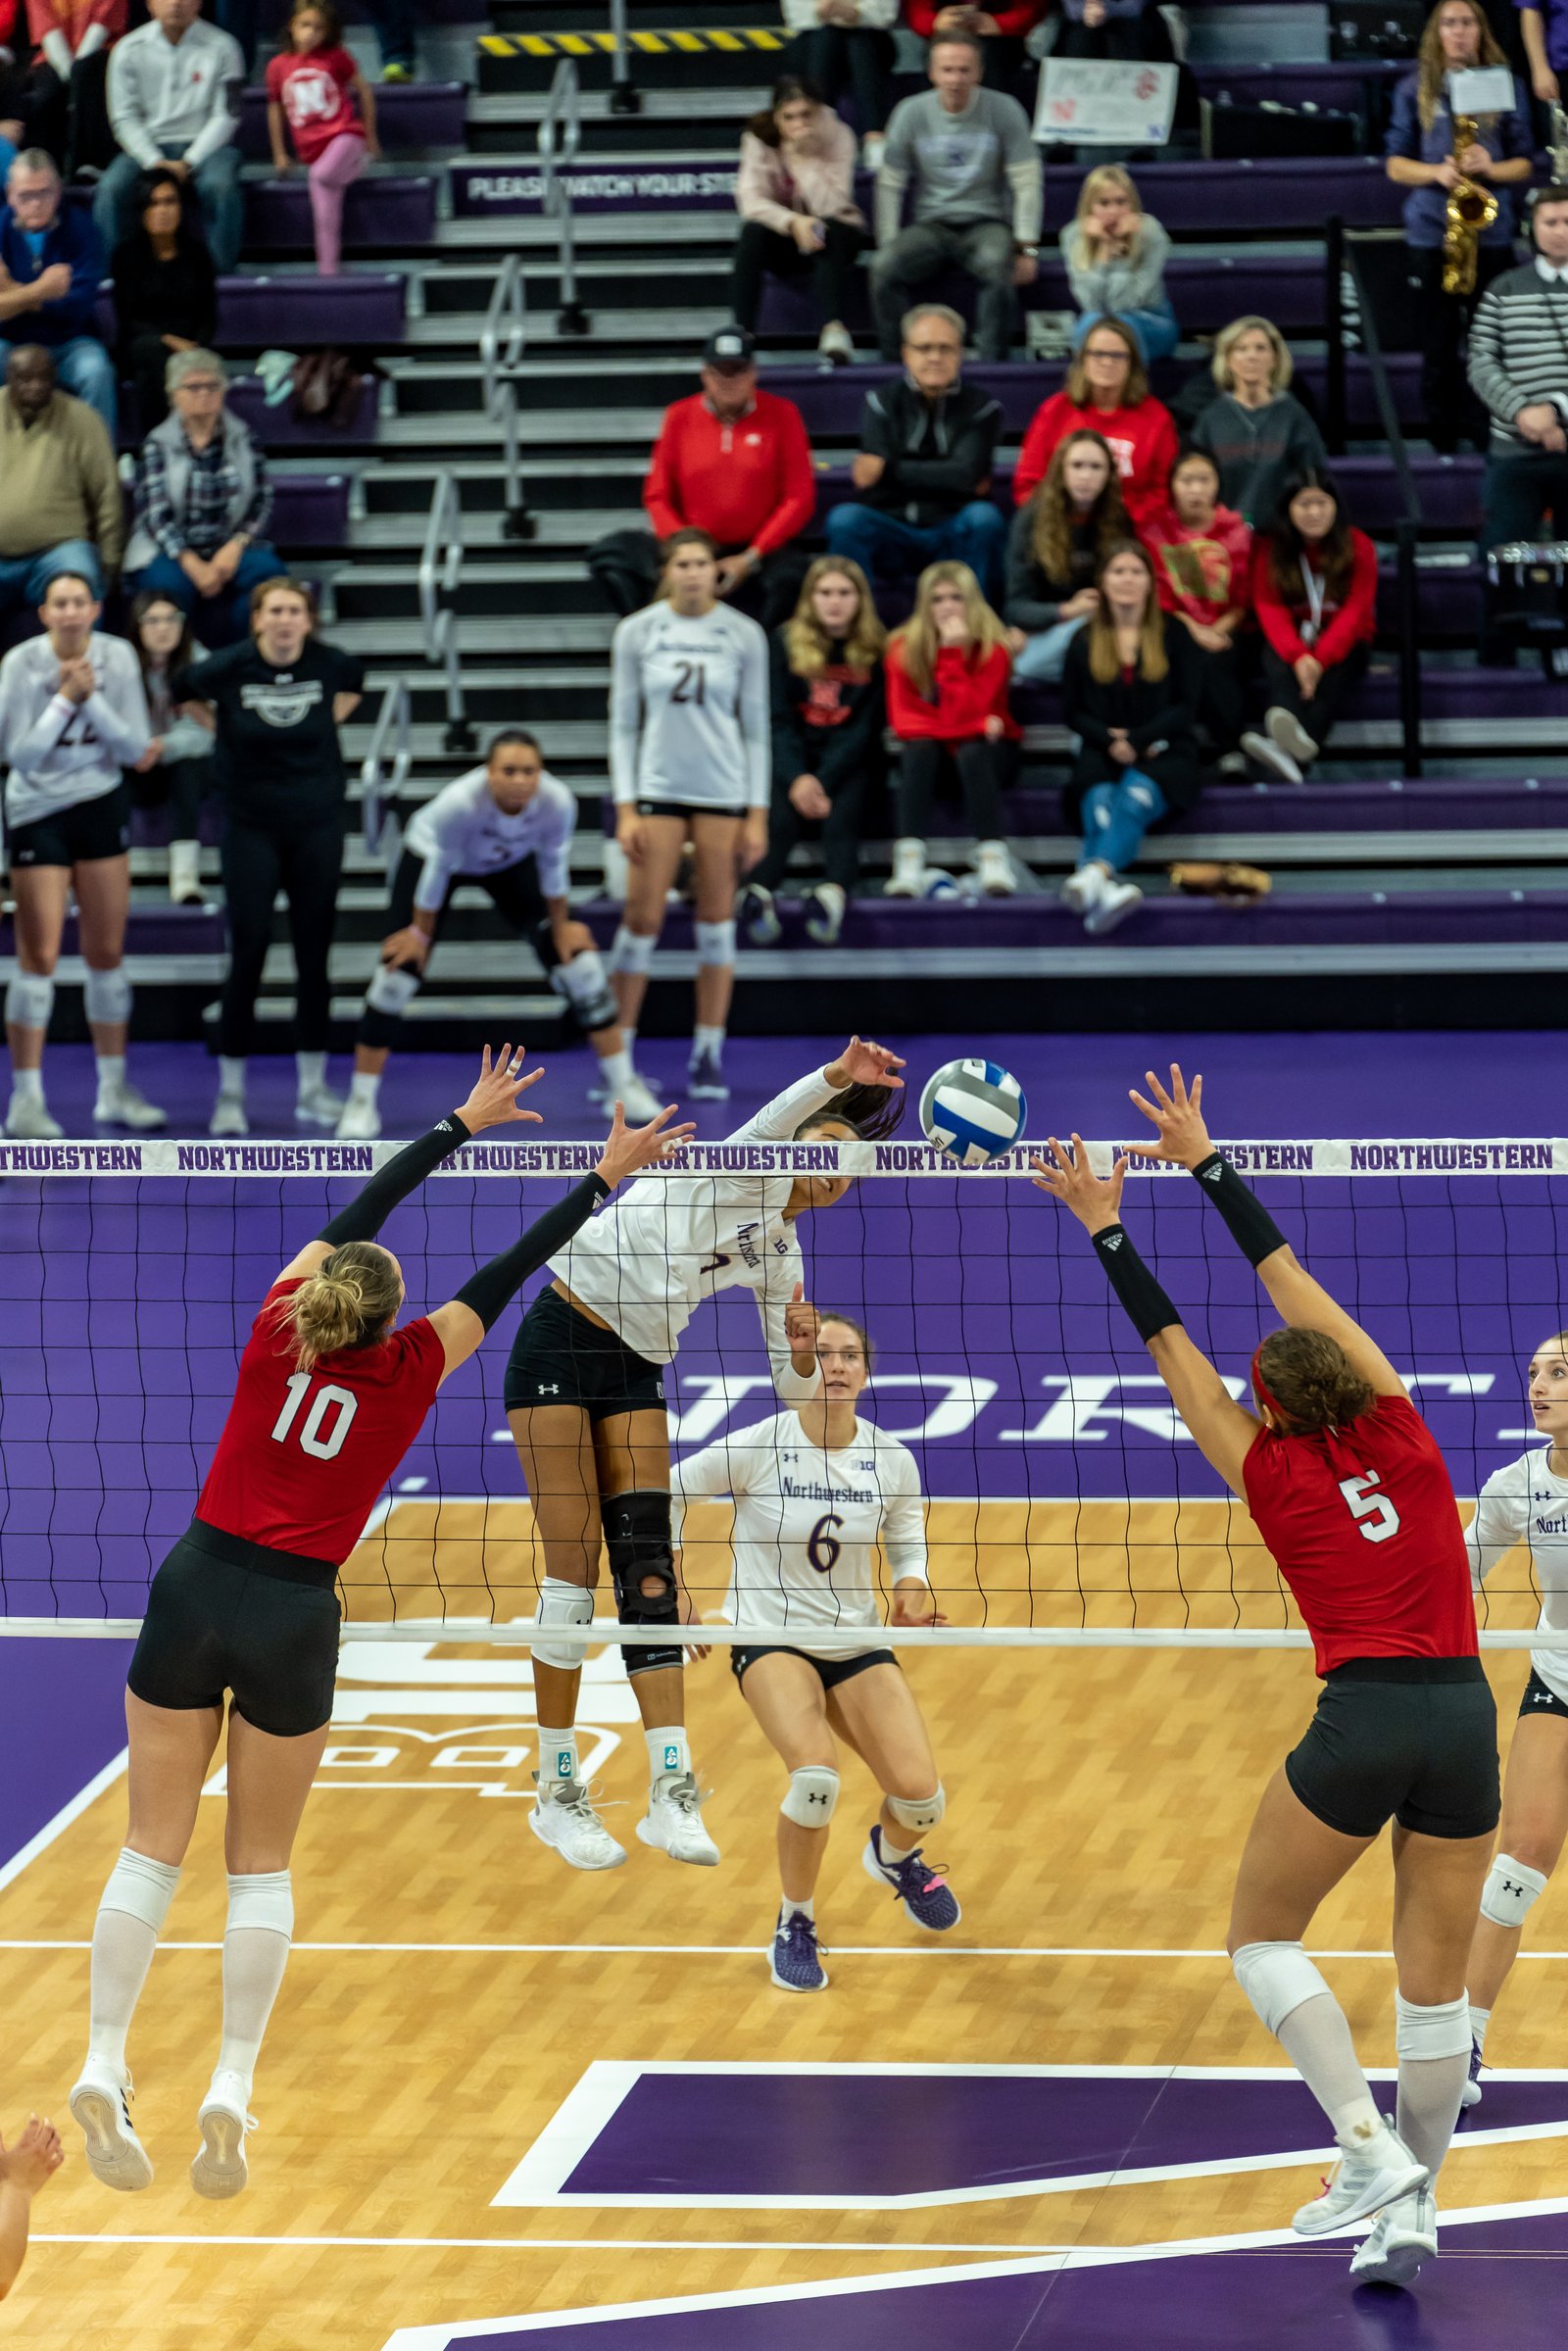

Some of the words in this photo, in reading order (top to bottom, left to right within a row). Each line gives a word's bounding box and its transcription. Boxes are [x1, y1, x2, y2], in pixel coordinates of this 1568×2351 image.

[468, 176, 549, 200] PLEAS
[697, 171, 739, 196] STE
[671, 661, 705, 706] 21
[177, 1146, 373, 1171] NORTHWESTERN
[432, 1146, 602, 1171] RTHWESTERN
[1349, 1144, 1553, 1170] NORTHWESTERN
[270, 1371, 360, 1461] 10
[783, 1476, 873, 1503] Northwestern
[1338, 1469, 1401, 1543] 5
[1536, 1512, 1568, 1535] Nort
[808, 1513, 845, 1574] 6
